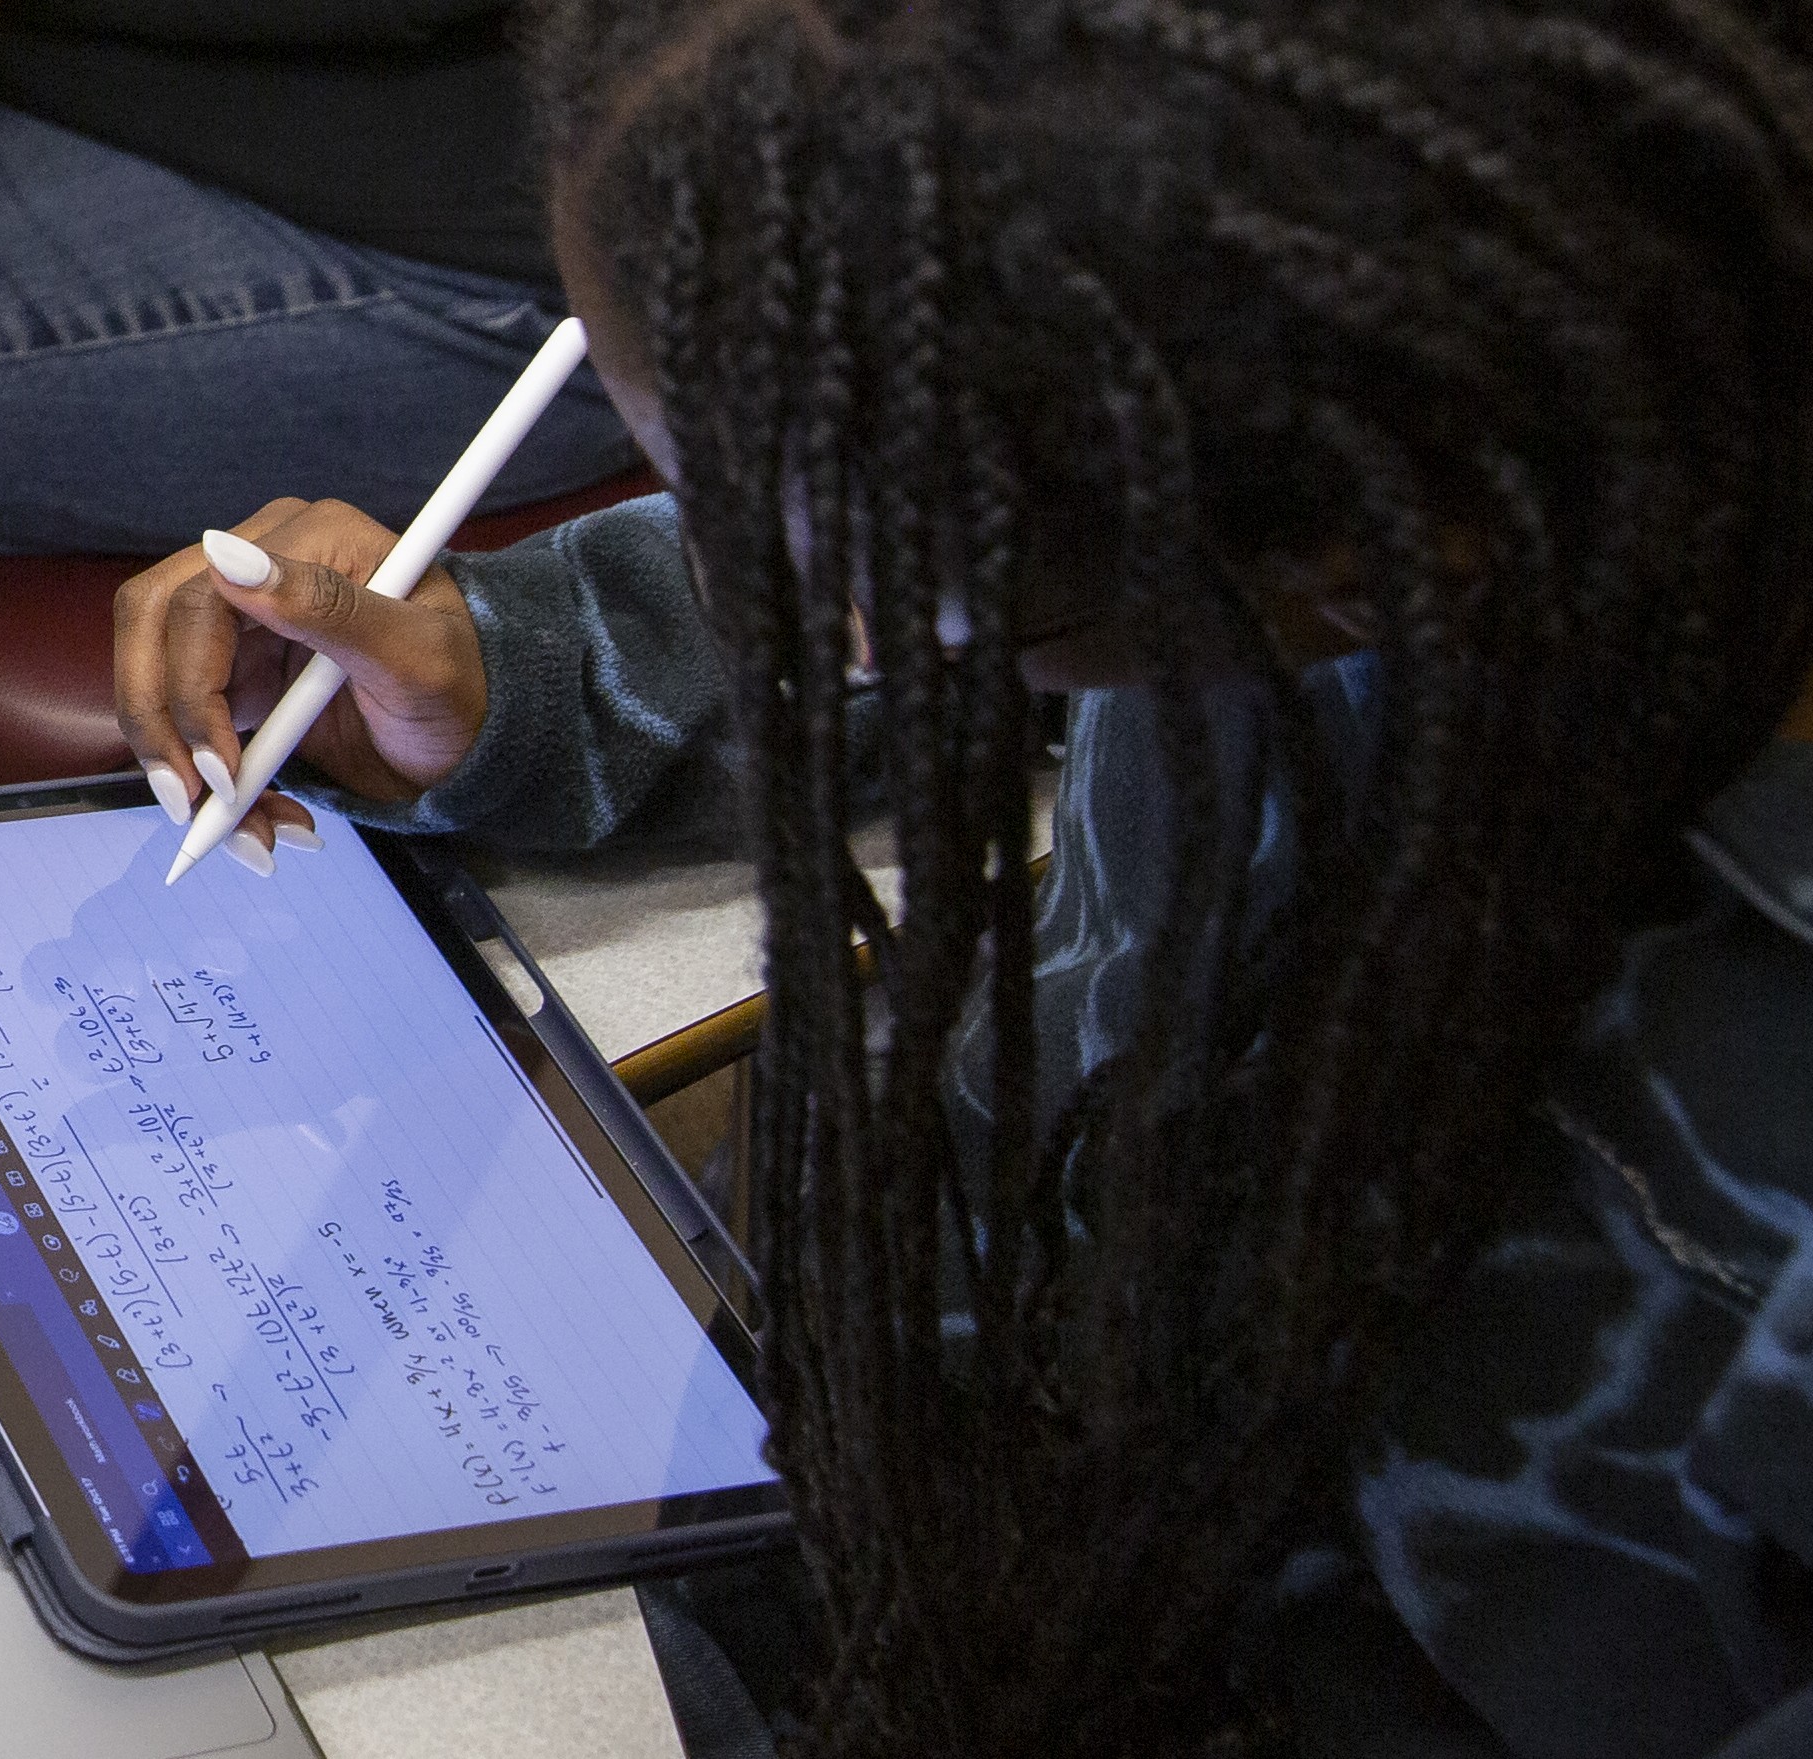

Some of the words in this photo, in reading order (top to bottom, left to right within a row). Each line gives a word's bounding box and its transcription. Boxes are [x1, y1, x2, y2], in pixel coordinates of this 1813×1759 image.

[364, 1286, 410, 1340] when
[426, 1327, 447, 1342] or
[65, 1398, 94, 1440] workbook
[88, 1440, 106, 1463] Math
[98, 1505, 112, 1523] Tue
